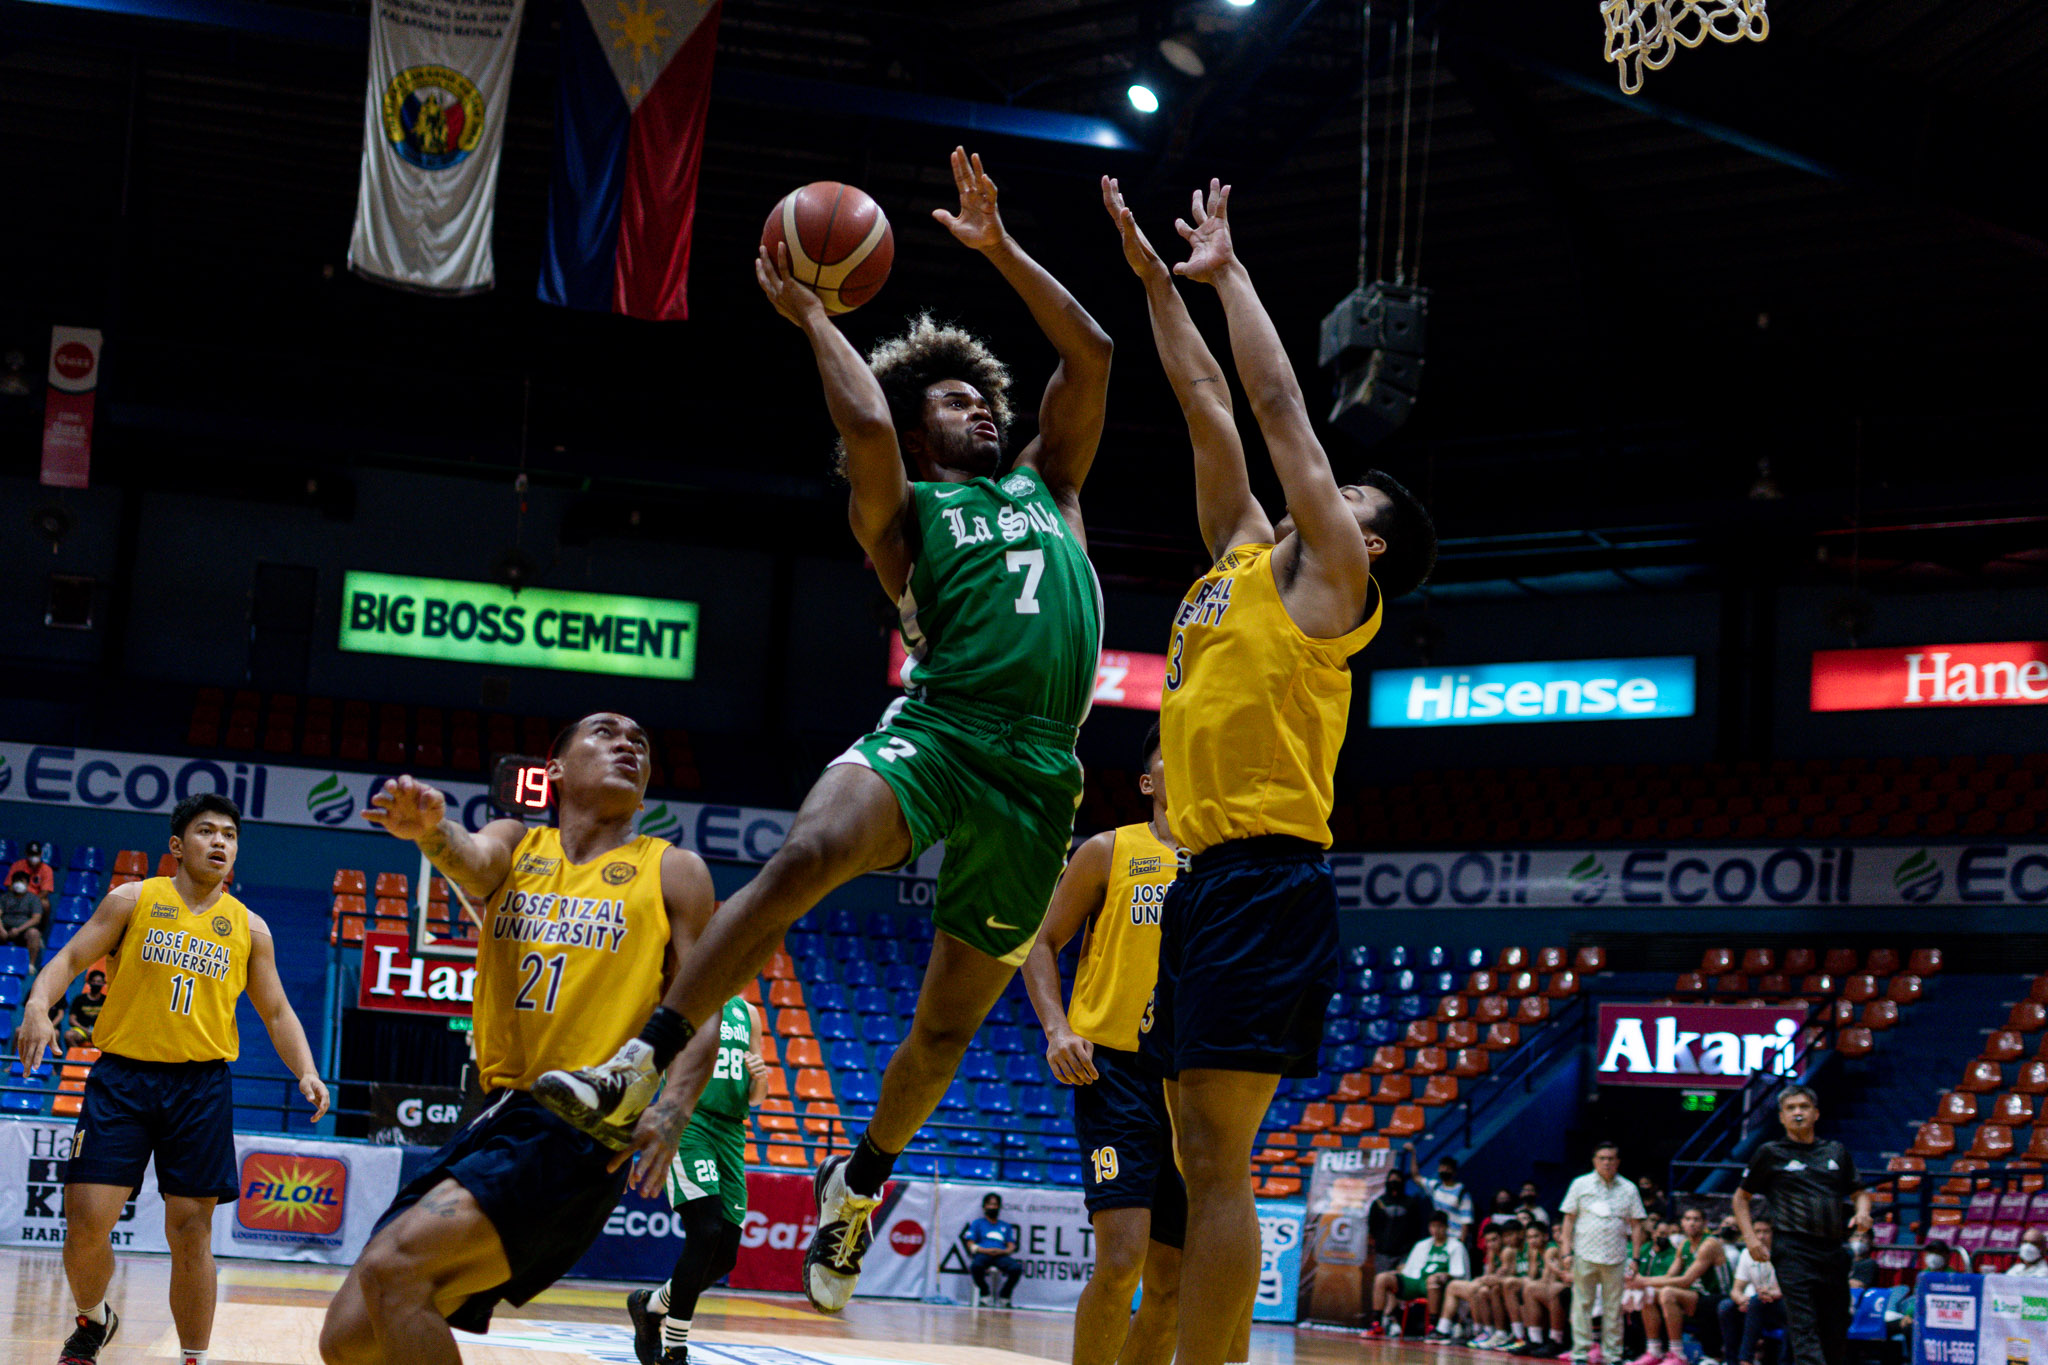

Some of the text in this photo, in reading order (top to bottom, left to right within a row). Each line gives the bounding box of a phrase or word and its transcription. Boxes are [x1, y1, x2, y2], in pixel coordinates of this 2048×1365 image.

[942, 507, 995, 549] La
[1005, 548, 1046, 615] 7
[350, 590, 693, 660] BIG BOSS CEMENT
[1405, 674, 1659, 722] Hisense
[24, 746, 267, 820] EcoOil
[514, 766, 549, 809] 19
[1328, 850, 1532, 907] EcoOil
[1621, 846, 1855, 905] EcoOil
[499, 888, 627, 925] JOSÉ RIZAL
[144, 927, 231, 965] JOSÉ RIZAL
[493, 915, 629, 953] UNIVERSITY
[141, 944, 231, 982] UNIVERSITY
[514, 951, 568, 1014] 21
[169, 973, 196, 1016] 11
[712, 1046, 745, 1081] 28
[1597, 1016, 1800, 1078] Akari
[694, 1159, 719, 1183] 28
[1090, 1145, 1120, 1185] 19
[1320, 1148, 1391, 1172] FUEL IT
[245, 1181, 339, 1206] FILOIL
[231, 1231, 278, 1242] LOGISTICS
